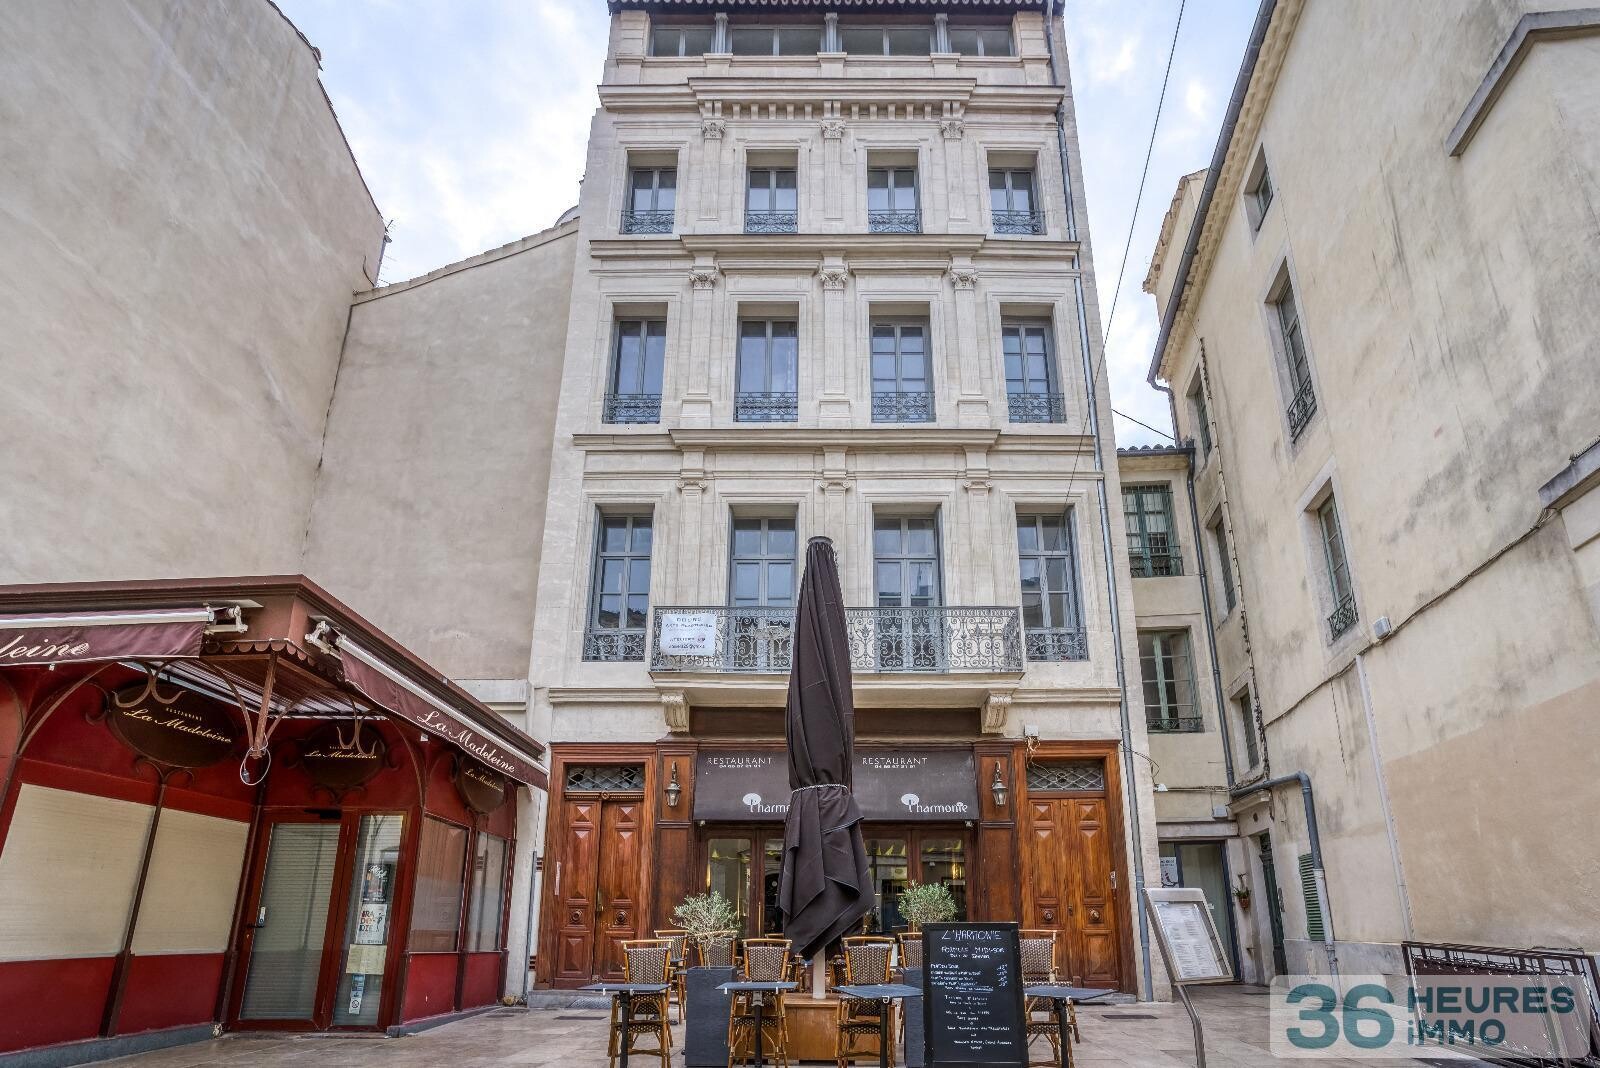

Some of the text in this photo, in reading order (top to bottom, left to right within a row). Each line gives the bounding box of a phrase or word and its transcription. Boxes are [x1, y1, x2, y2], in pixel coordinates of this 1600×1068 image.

[123, 708, 232, 743] La Madeleine
[416, 710, 515, 773] La Madeleine
[707, 757, 773, 765] RESTAURANT
[862, 757, 928, 765] RESTAURANT
[908, 799, 969, 813] l'harmonie
